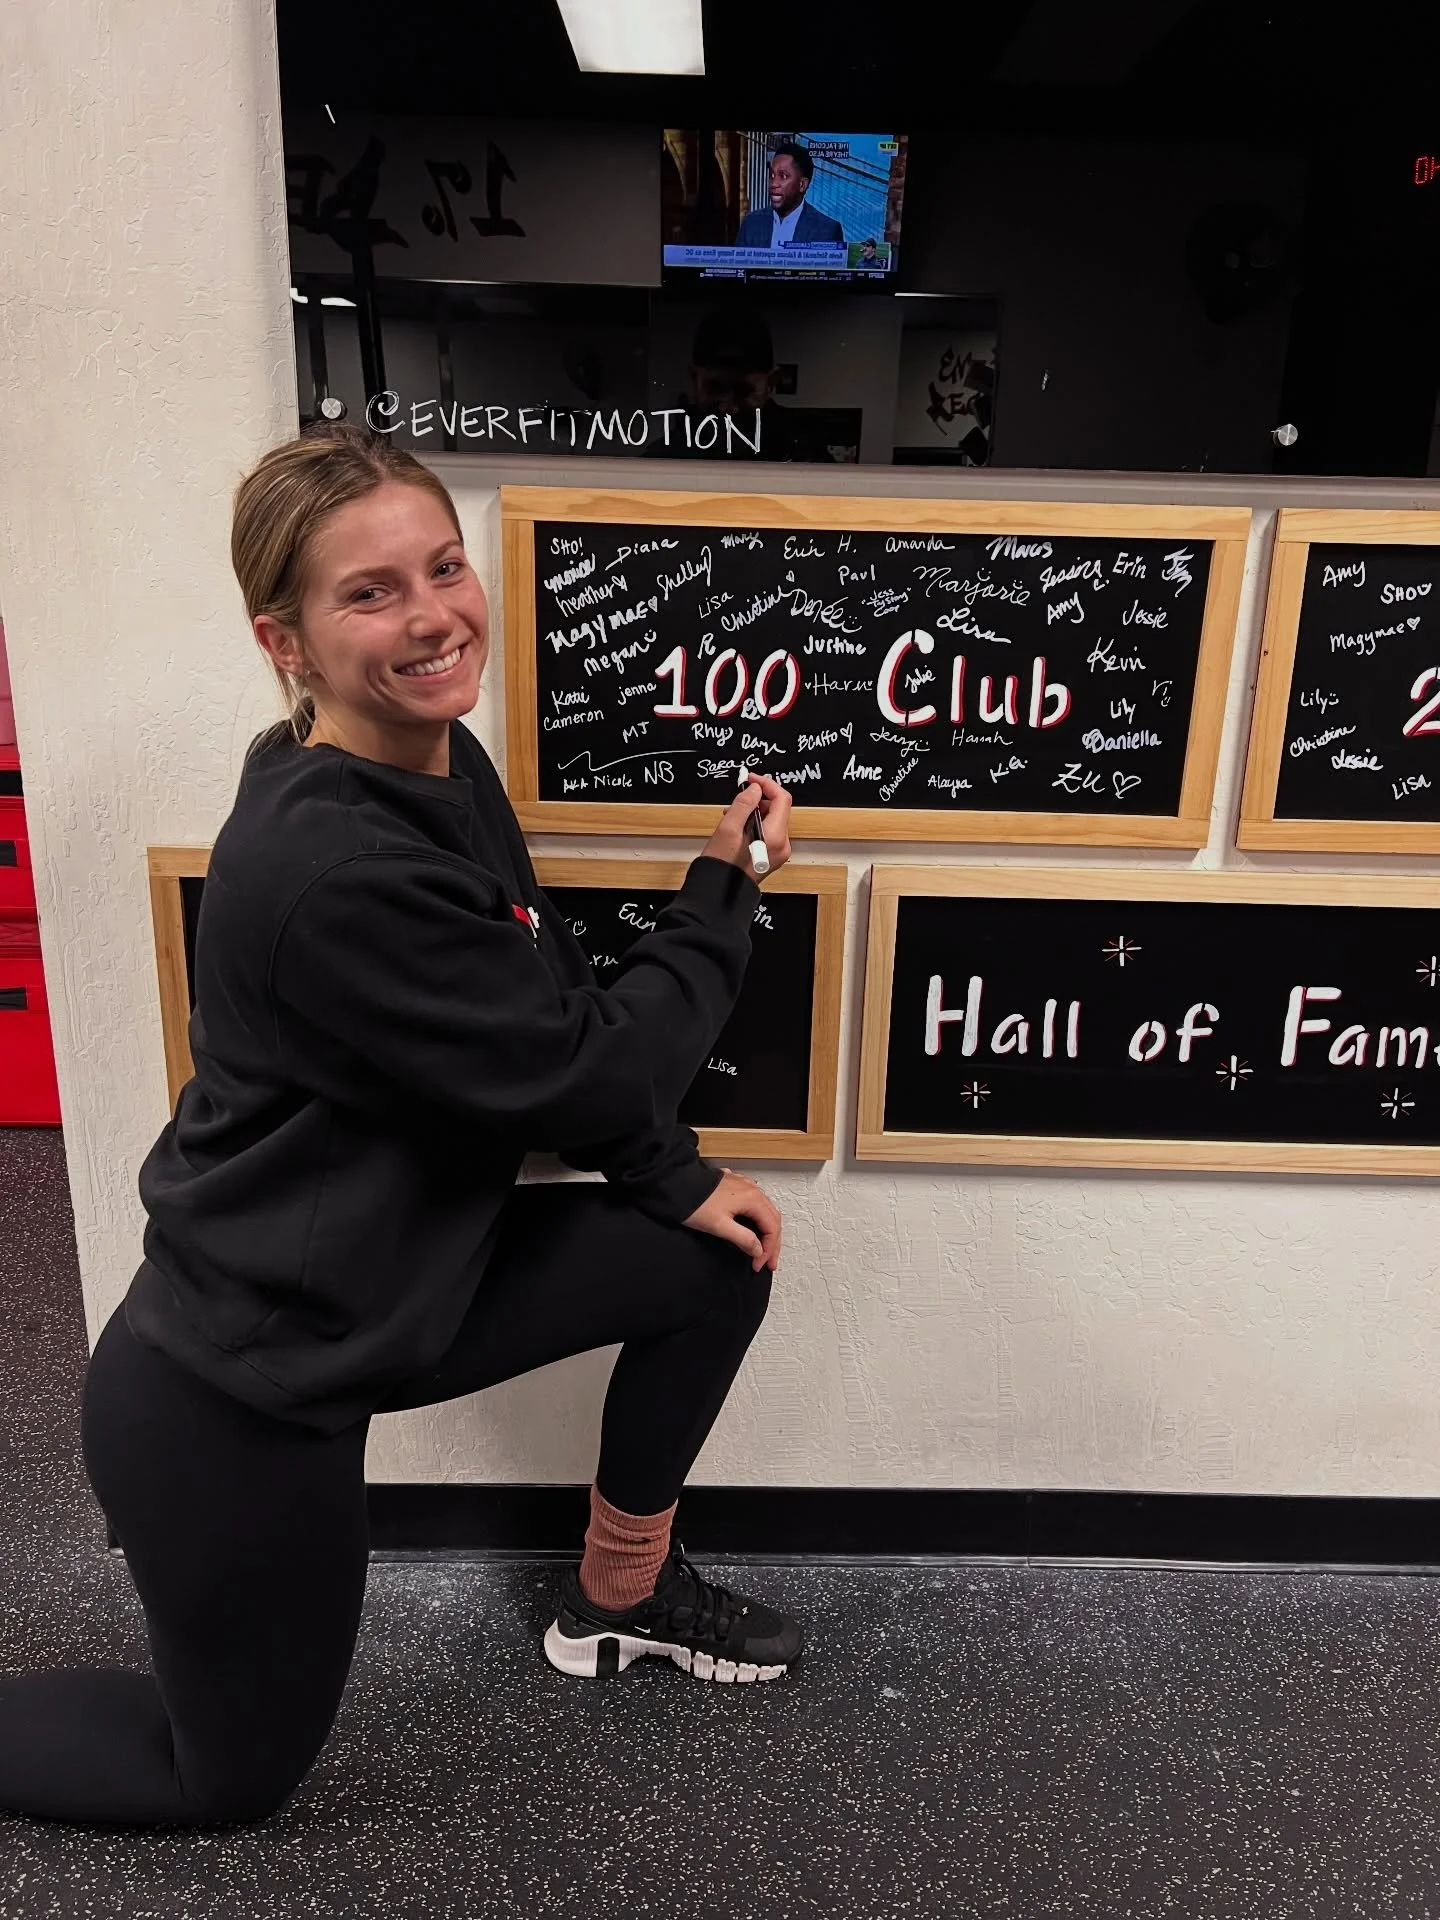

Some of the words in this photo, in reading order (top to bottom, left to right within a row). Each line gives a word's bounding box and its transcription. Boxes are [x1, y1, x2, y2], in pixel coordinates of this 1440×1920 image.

[605, 540, 679, 571] Diana
[837, 534, 857, 554] H.
[837, 564, 876, 586] Paul
[1112, 552, 1147, 579] Erin
[1322, 561, 1366, 588] Amy
[1047, 591, 1085, 626] Amy
[803, 634, 867, 655] Justine
[1086, 636, 1146, 673] Kevin
[653, 645, 800, 719] 100
[876, 628, 1072, 729] Club
[543, 708, 605, 731] Cameron
[622, 720, 650, 744] MJ
[1081, 728, 1163, 754] Daniella
[644, 760, 675, 785] NB
[745, 753, 763, 767] G.
[842, 754, 883, 782] Anne
[924, 974, 1081, 1058] Hall
[1128, 1002, 1220, 1064] of
[1280, 985, 1440, 1069] Fam
[707, 1056, 738, 1076] Lisa
